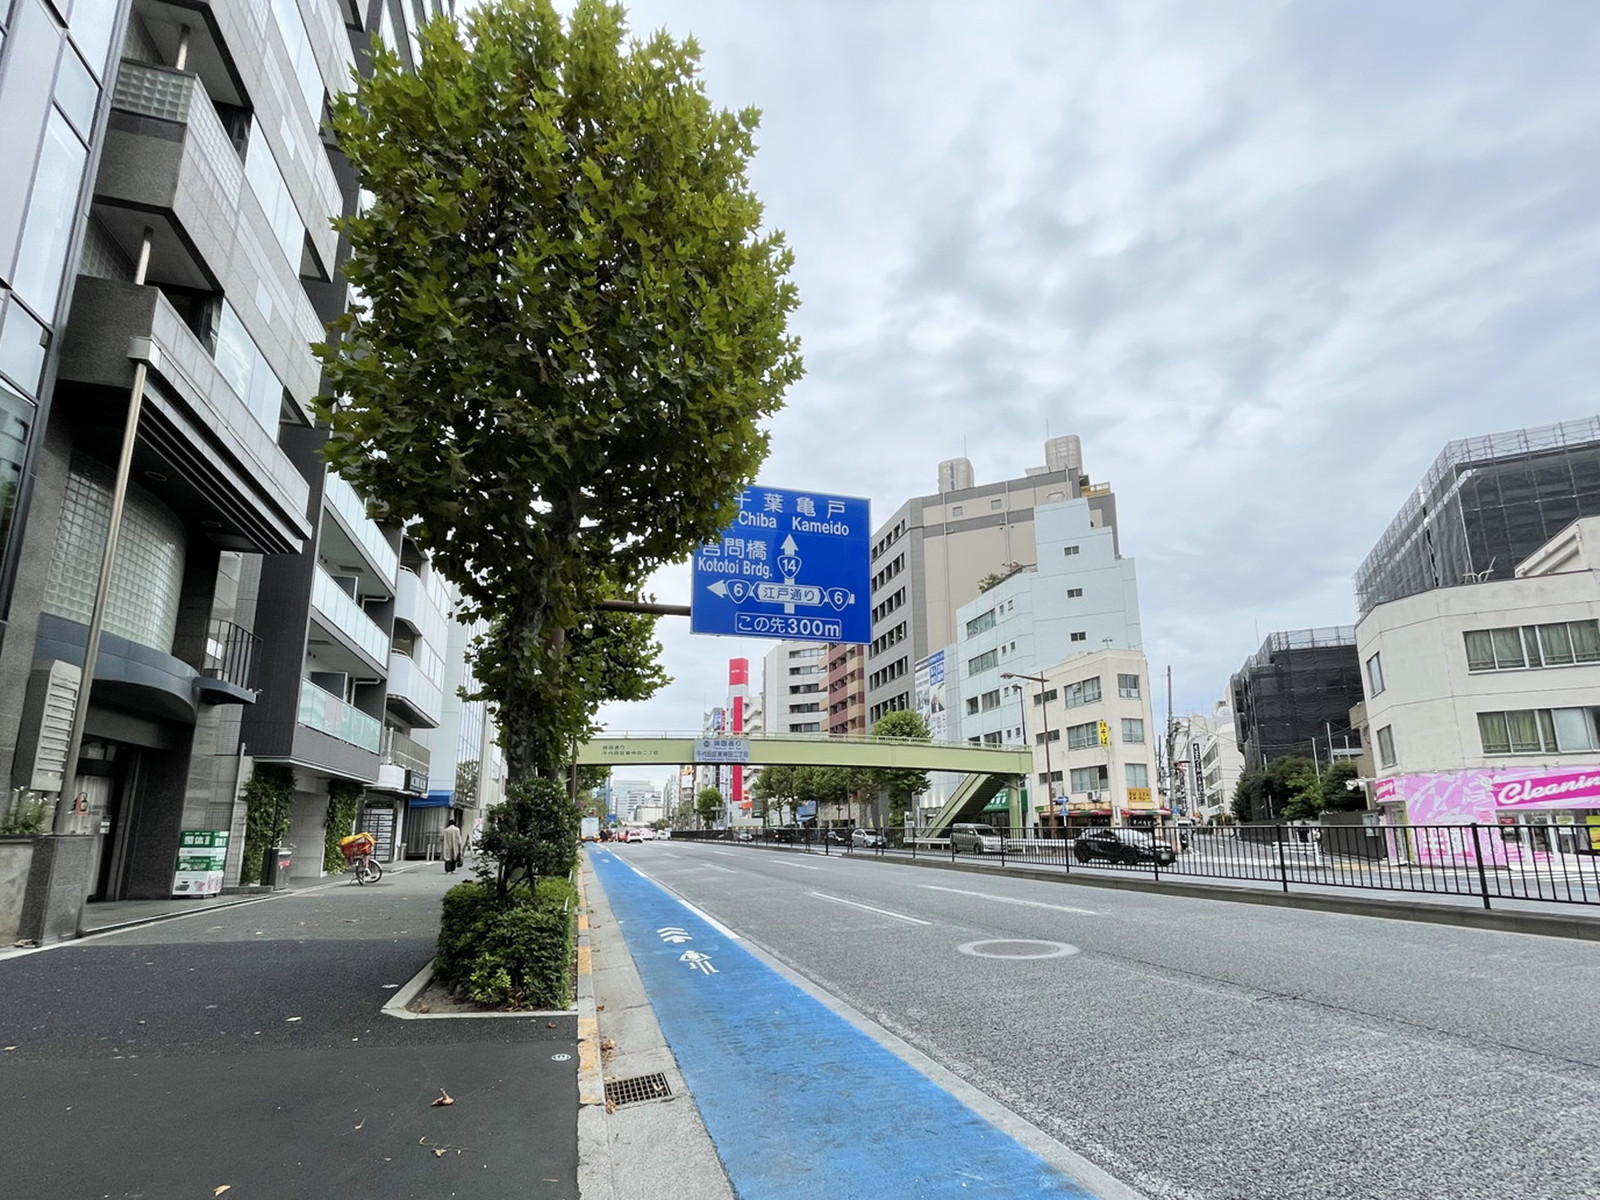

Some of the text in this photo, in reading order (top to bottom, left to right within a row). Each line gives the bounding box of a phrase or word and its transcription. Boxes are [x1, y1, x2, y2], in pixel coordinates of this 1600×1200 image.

[796, 497, 845, 519] 亀戸
[738, 511, 849, 536] Chiba Kameido
[698, 557, 773, 579] Kototoi Brdg.
[782, 559, 797, 572] 14
[733, 583, 744, 597] 6
[763, 586, 815, 602] 江戸通り
[834, 591, 844, 605] 6
[738, 616, 840, 637] この先300m
